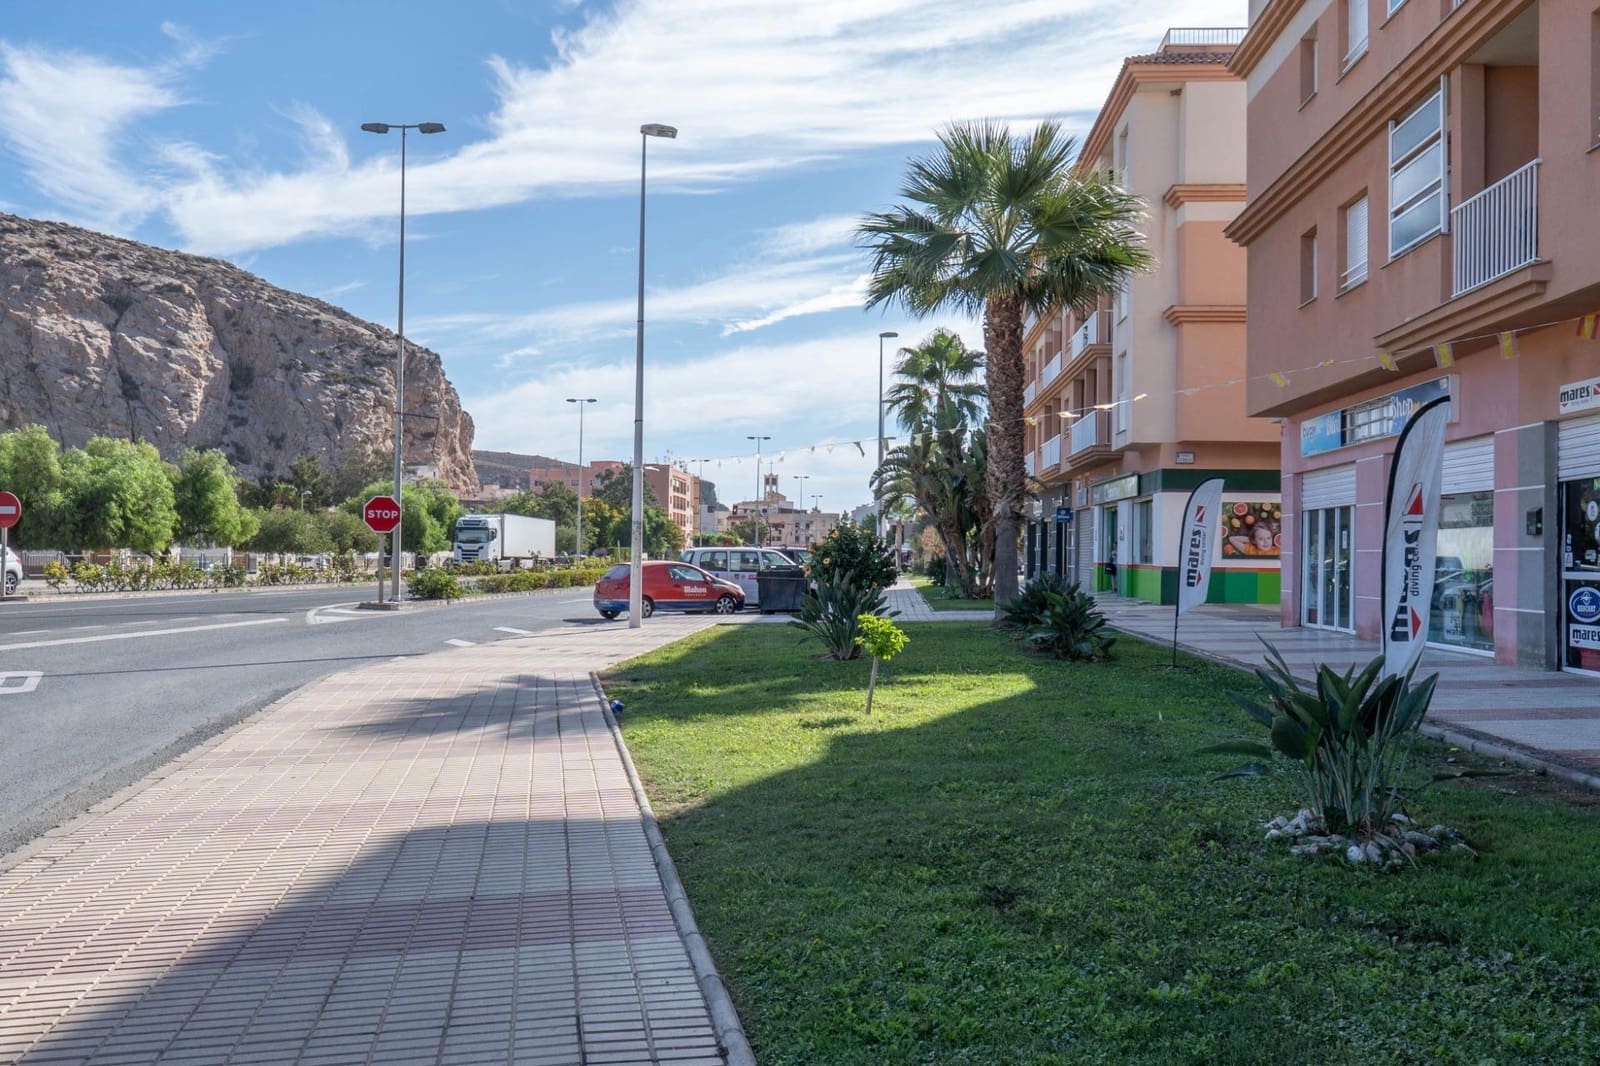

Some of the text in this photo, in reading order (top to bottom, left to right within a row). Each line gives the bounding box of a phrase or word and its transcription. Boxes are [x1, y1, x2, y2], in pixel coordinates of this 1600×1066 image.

[1560, 385, 1590, 402] mares
[367, 510, 398, 519] STOP
[1186, 528, 1201, 587] mares
[1408, 564, 1422, 597] diving
